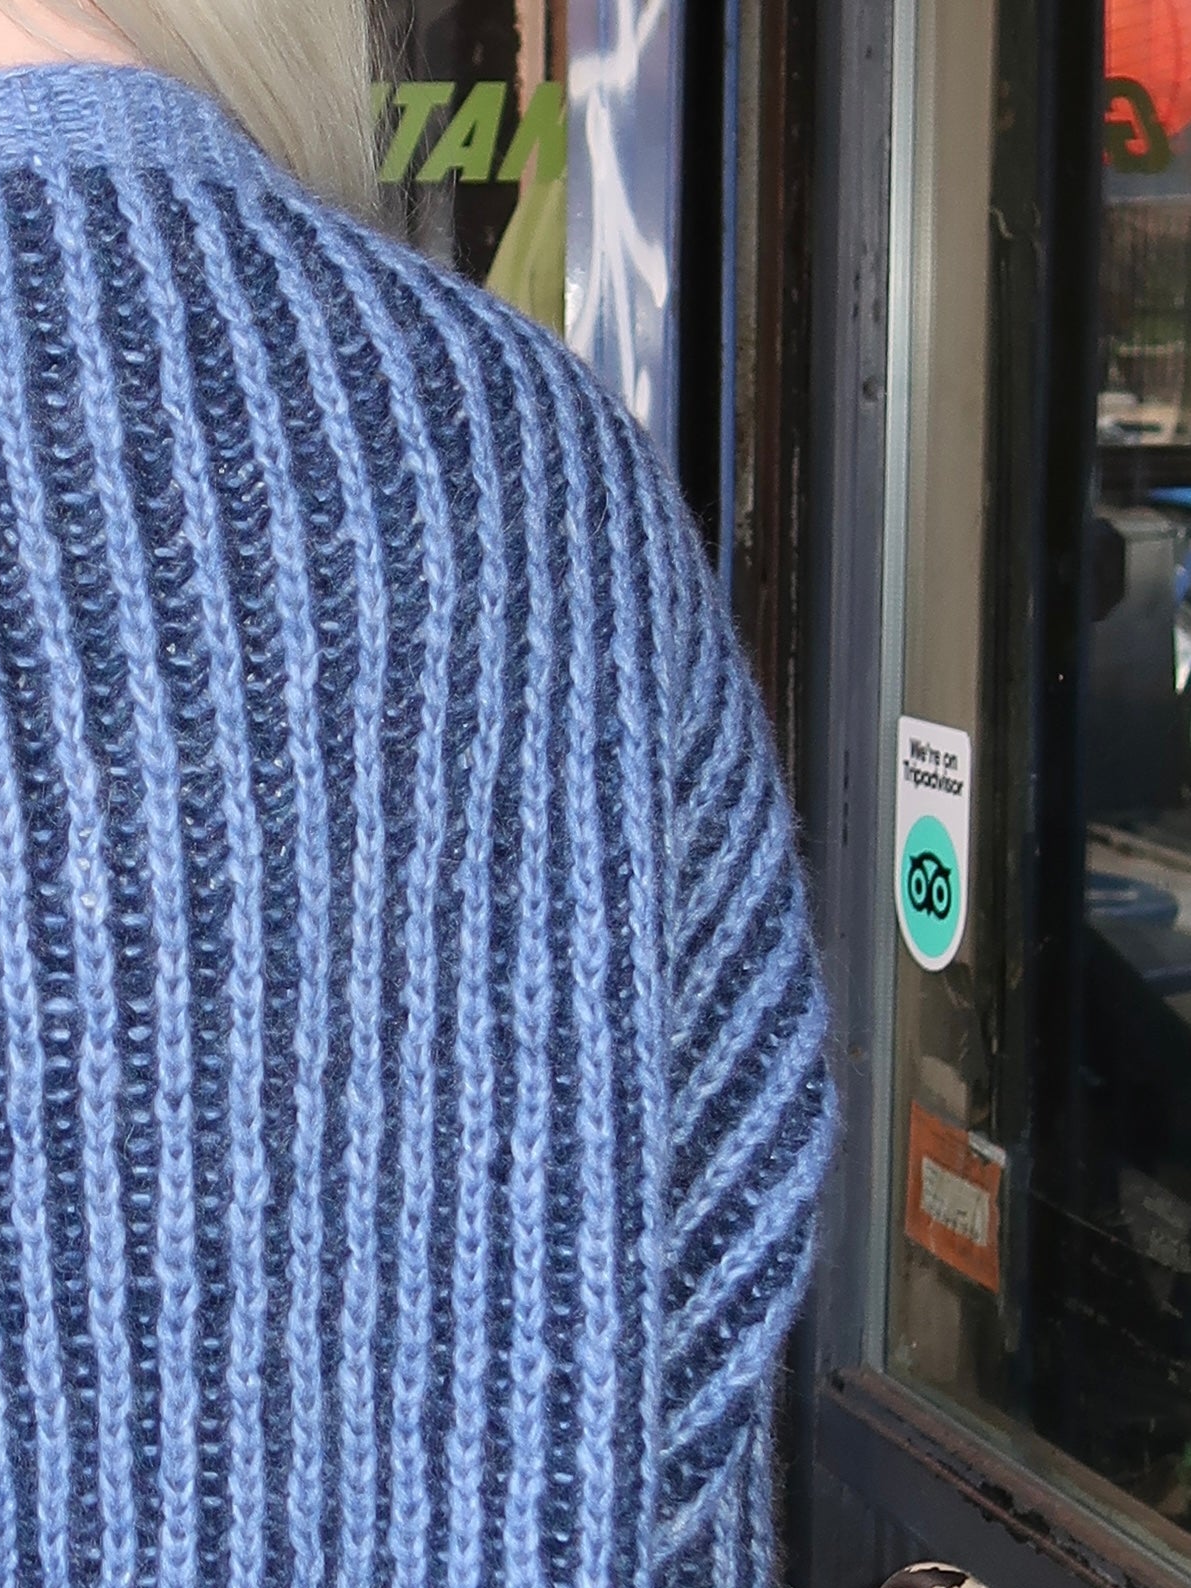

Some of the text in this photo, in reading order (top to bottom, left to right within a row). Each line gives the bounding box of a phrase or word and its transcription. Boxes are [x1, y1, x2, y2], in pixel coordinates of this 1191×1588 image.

[909, 737, 958, 771] We're on
[903, 760, 964, 796] Tripadvisor
